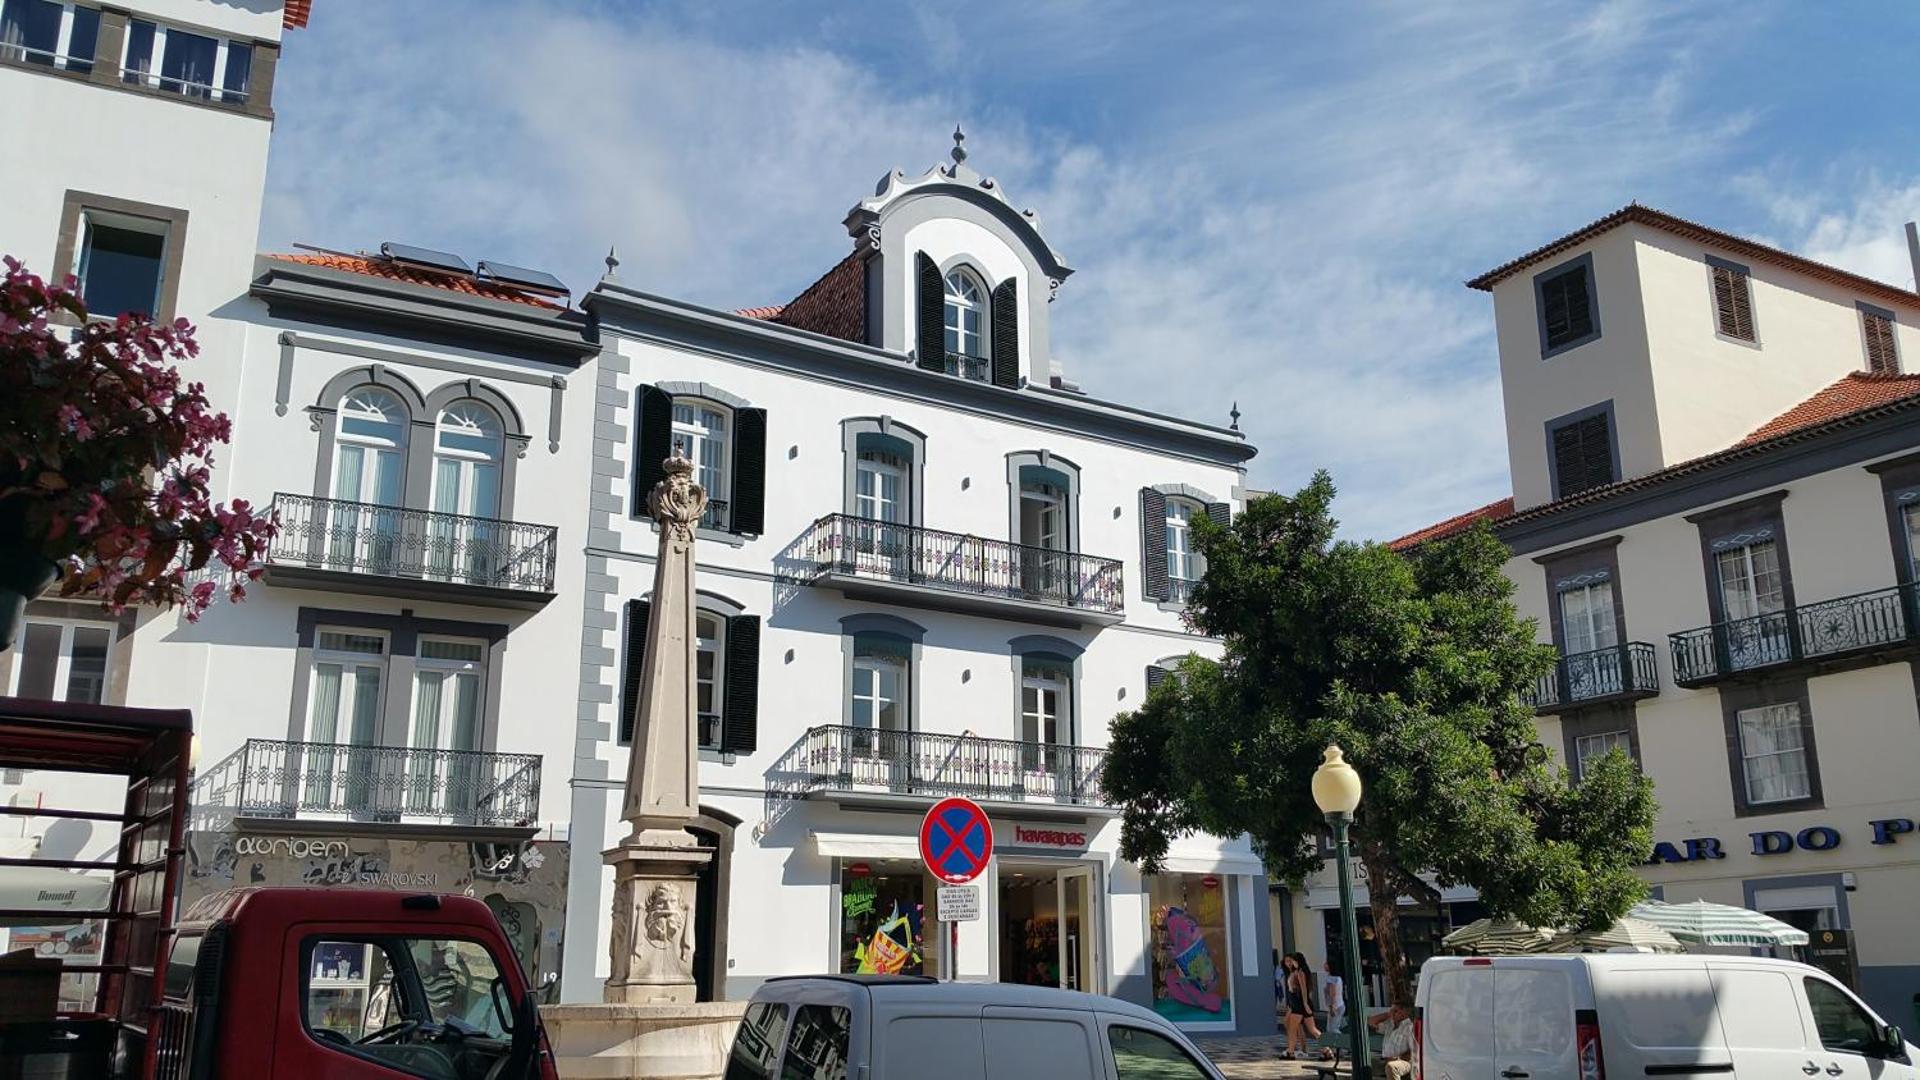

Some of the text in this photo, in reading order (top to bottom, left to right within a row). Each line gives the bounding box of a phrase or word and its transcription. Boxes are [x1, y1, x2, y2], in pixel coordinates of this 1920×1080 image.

[1642, 818, 1920, 866] AR DO P
[360, 872, 438, 886] SWAROVSKI
[543, 972, 558, 983] 19
